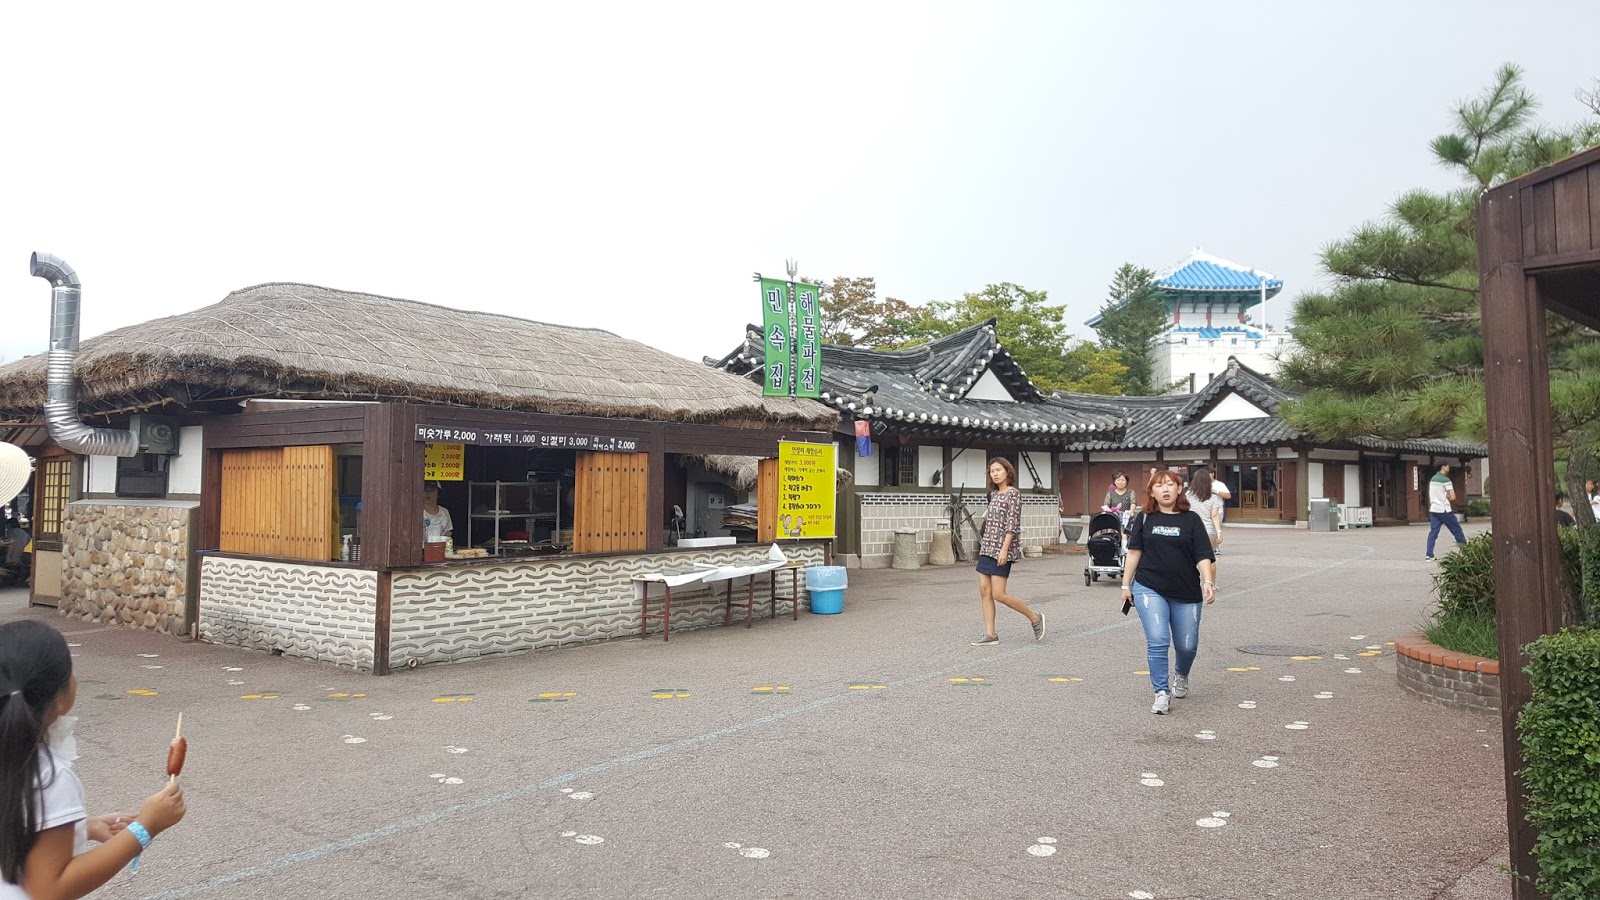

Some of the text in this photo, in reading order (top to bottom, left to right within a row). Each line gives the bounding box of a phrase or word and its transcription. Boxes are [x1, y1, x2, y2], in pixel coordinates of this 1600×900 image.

[767, 288, 785, 388] 민속집
[800, 291, 816, 391] 해물파전
[418, 428, 477, 441] 미숫가루 2,000
[484, 433, 536, 444] 가래떡 1,000
[541, 435, 588, 447] 인절미 3,000
[617, 440, 636, 450] 2,000
